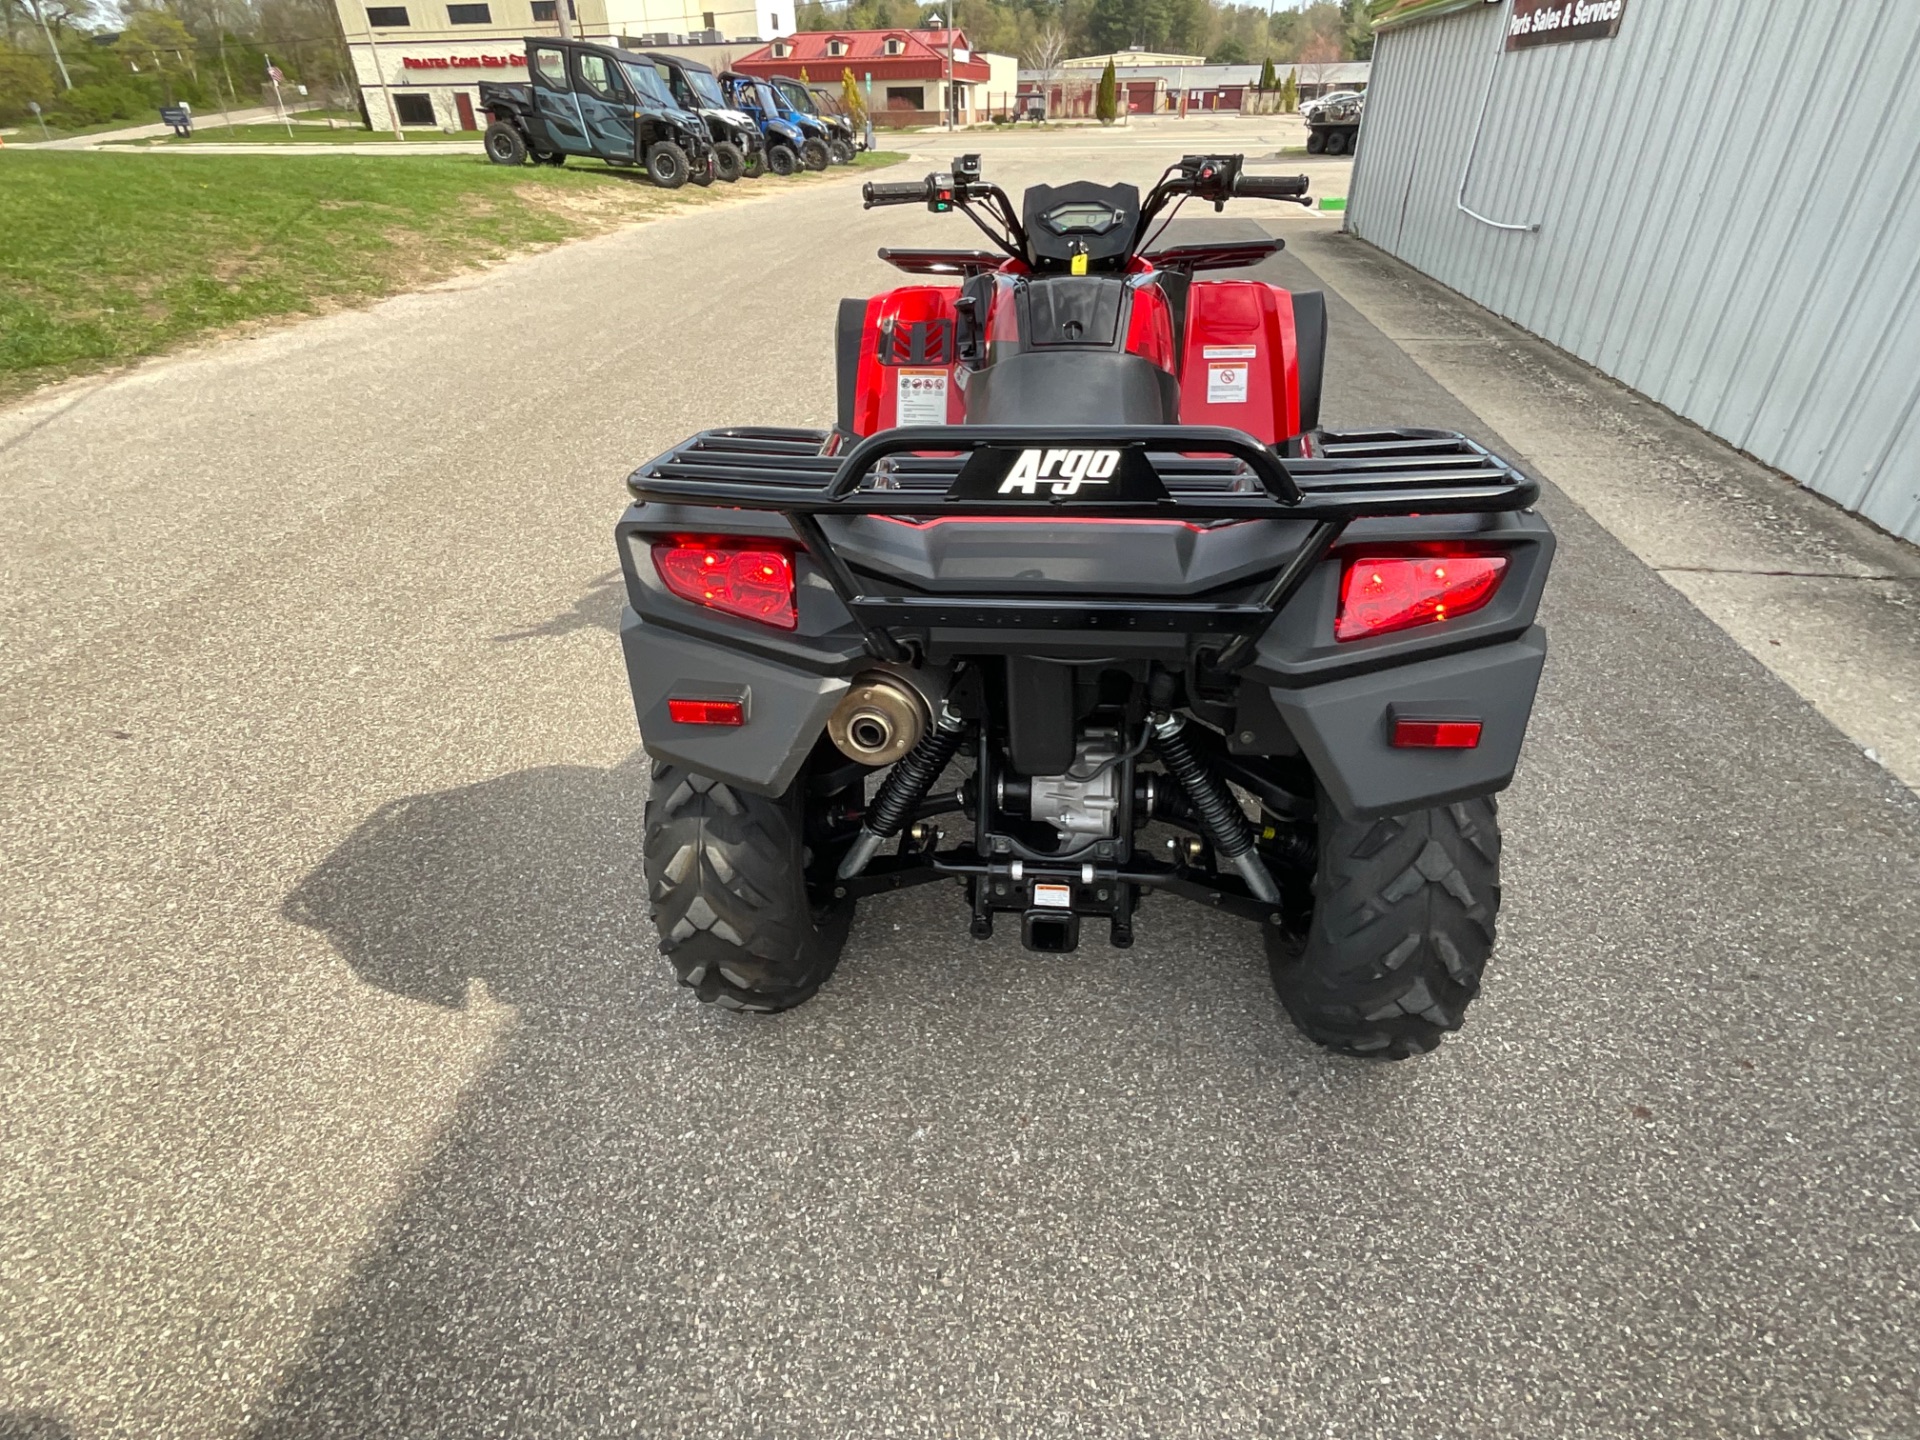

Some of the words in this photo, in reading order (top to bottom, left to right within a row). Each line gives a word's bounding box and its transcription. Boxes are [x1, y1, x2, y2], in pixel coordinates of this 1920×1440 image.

[1508, 12, 1531, 36] Parts
[1531, 7, 1561, 32] Sales
[1561, 2, 1572, 27] &
[1573, 0, 1621, 26] Service
[997, 449, 1121, 495] Argo
